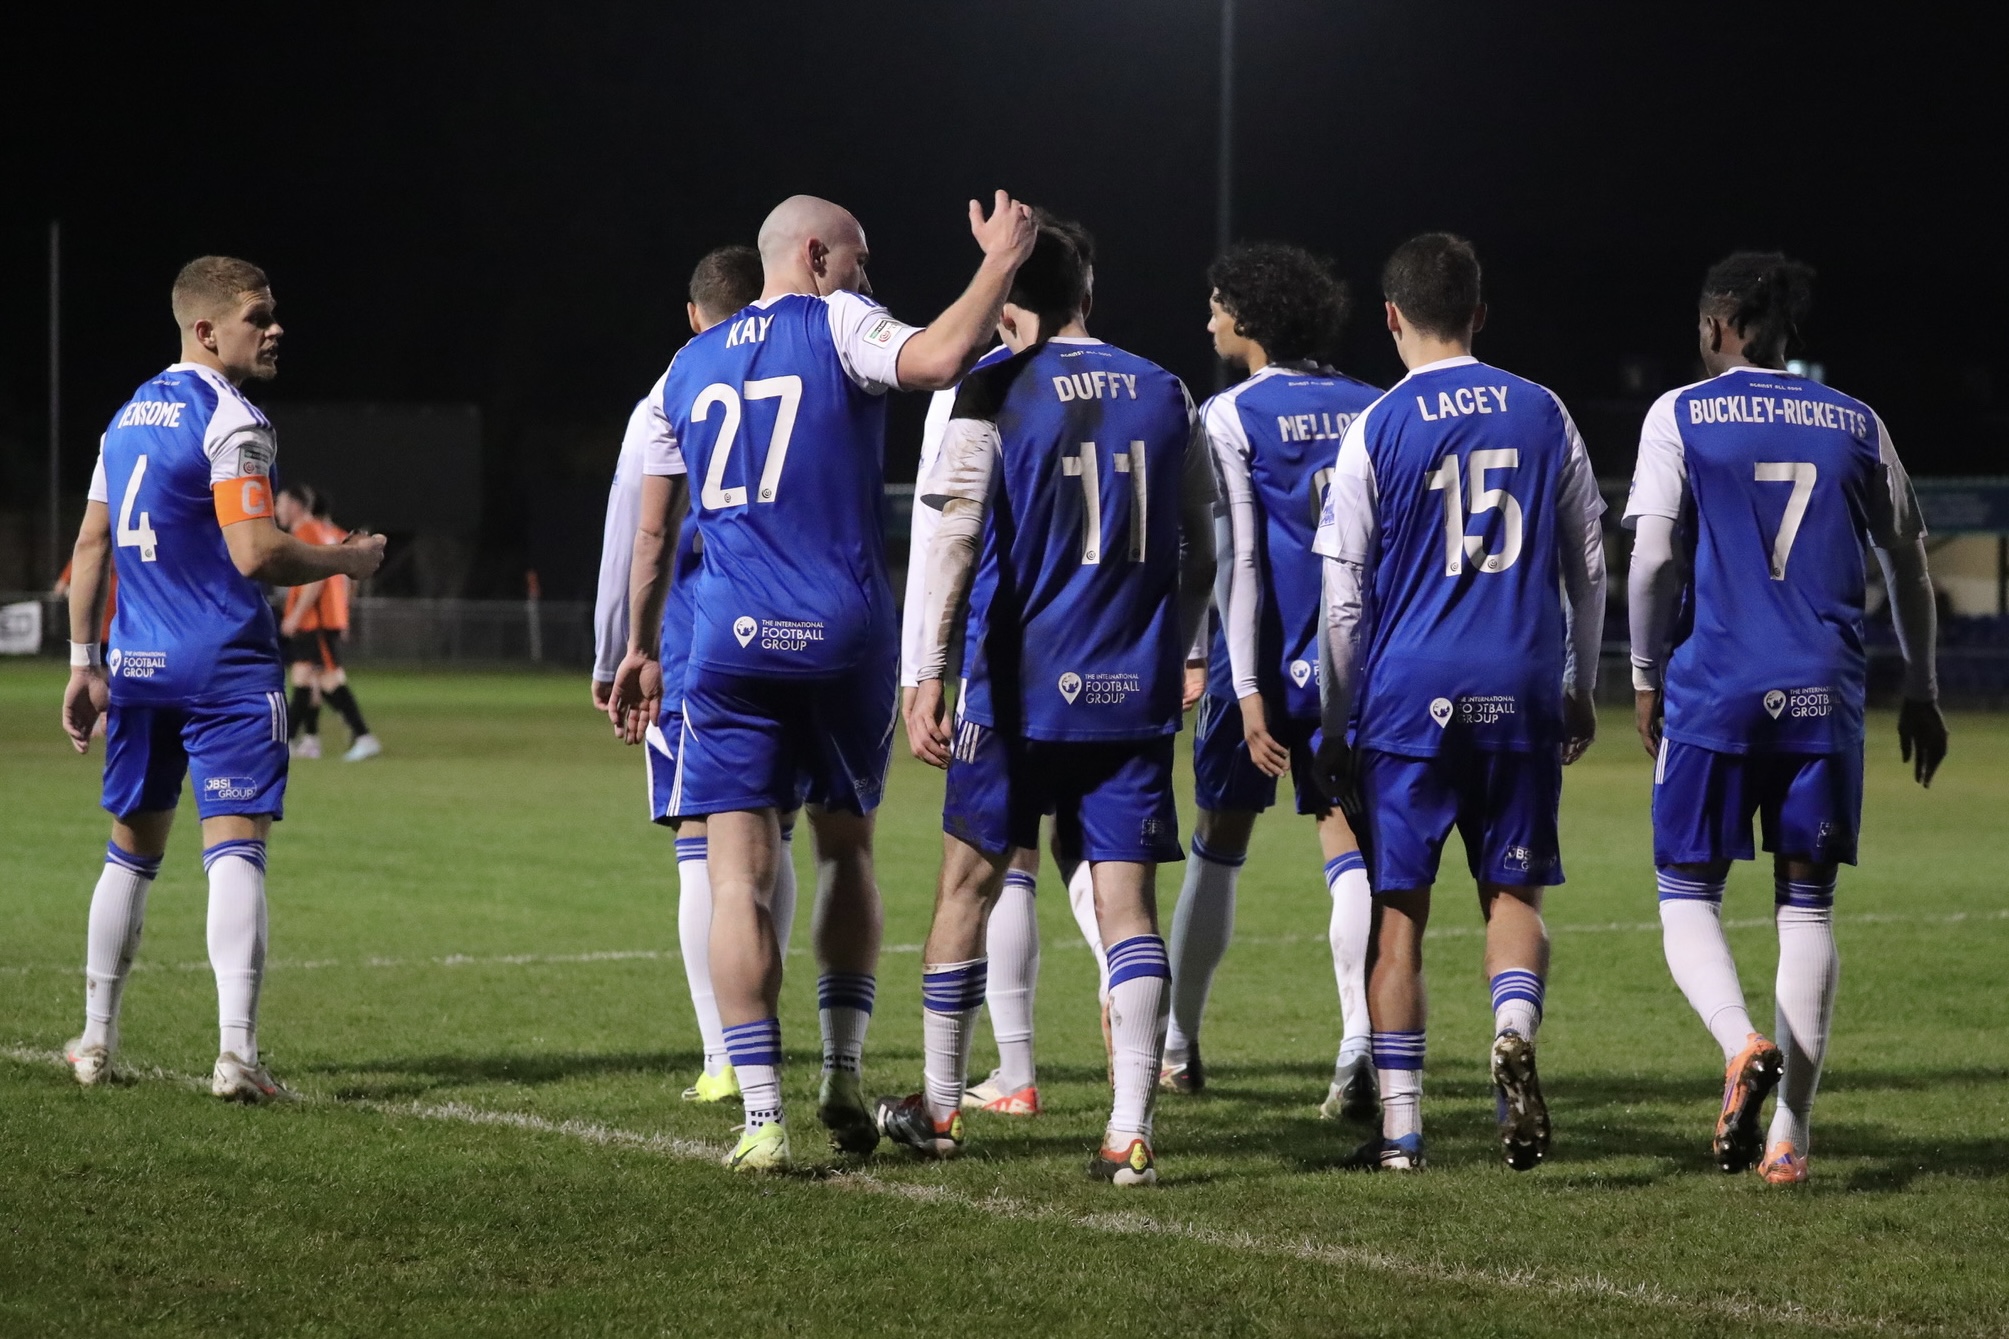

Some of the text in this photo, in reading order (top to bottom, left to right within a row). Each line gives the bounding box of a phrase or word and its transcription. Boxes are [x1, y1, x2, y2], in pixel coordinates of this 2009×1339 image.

[726, 314, 774, 349] KAY
[1053, 371, 1138, 402] DUFFY
[1417, 386, 1508, 422] LACEY
[1689, 396, 1867, 438] BUCKLEY-RICKETTS
[690, 374, 803, 511] 27
[1277, 412, 1360, 443] MELLO
[117, 454, 158, 562] 4
[241, 480, 266, 515] C
[1062, 440, 1147, 565] 11
[1425, 448, 1523, 577] 15
[1754, 462, 1817, 581] 7
[761, 619, 824, 629] THE INTERNATIONAL
[761, 627, 824, 641] FOOTBALL
[761, 638, 807, 652] GROUP
[123, 657, 166, 667] FOOTBALL
[123, 667, 154, 677] GROUP
[1085, 681, 1140, 693] FOOTBALL
[1085, 692, 1126, 704] GROUP
[1456, 703, 1515, 714] OOTBALL
[1791, 706, 1832, 717] GROUP
[218, 788, 254, 799] GROUP
